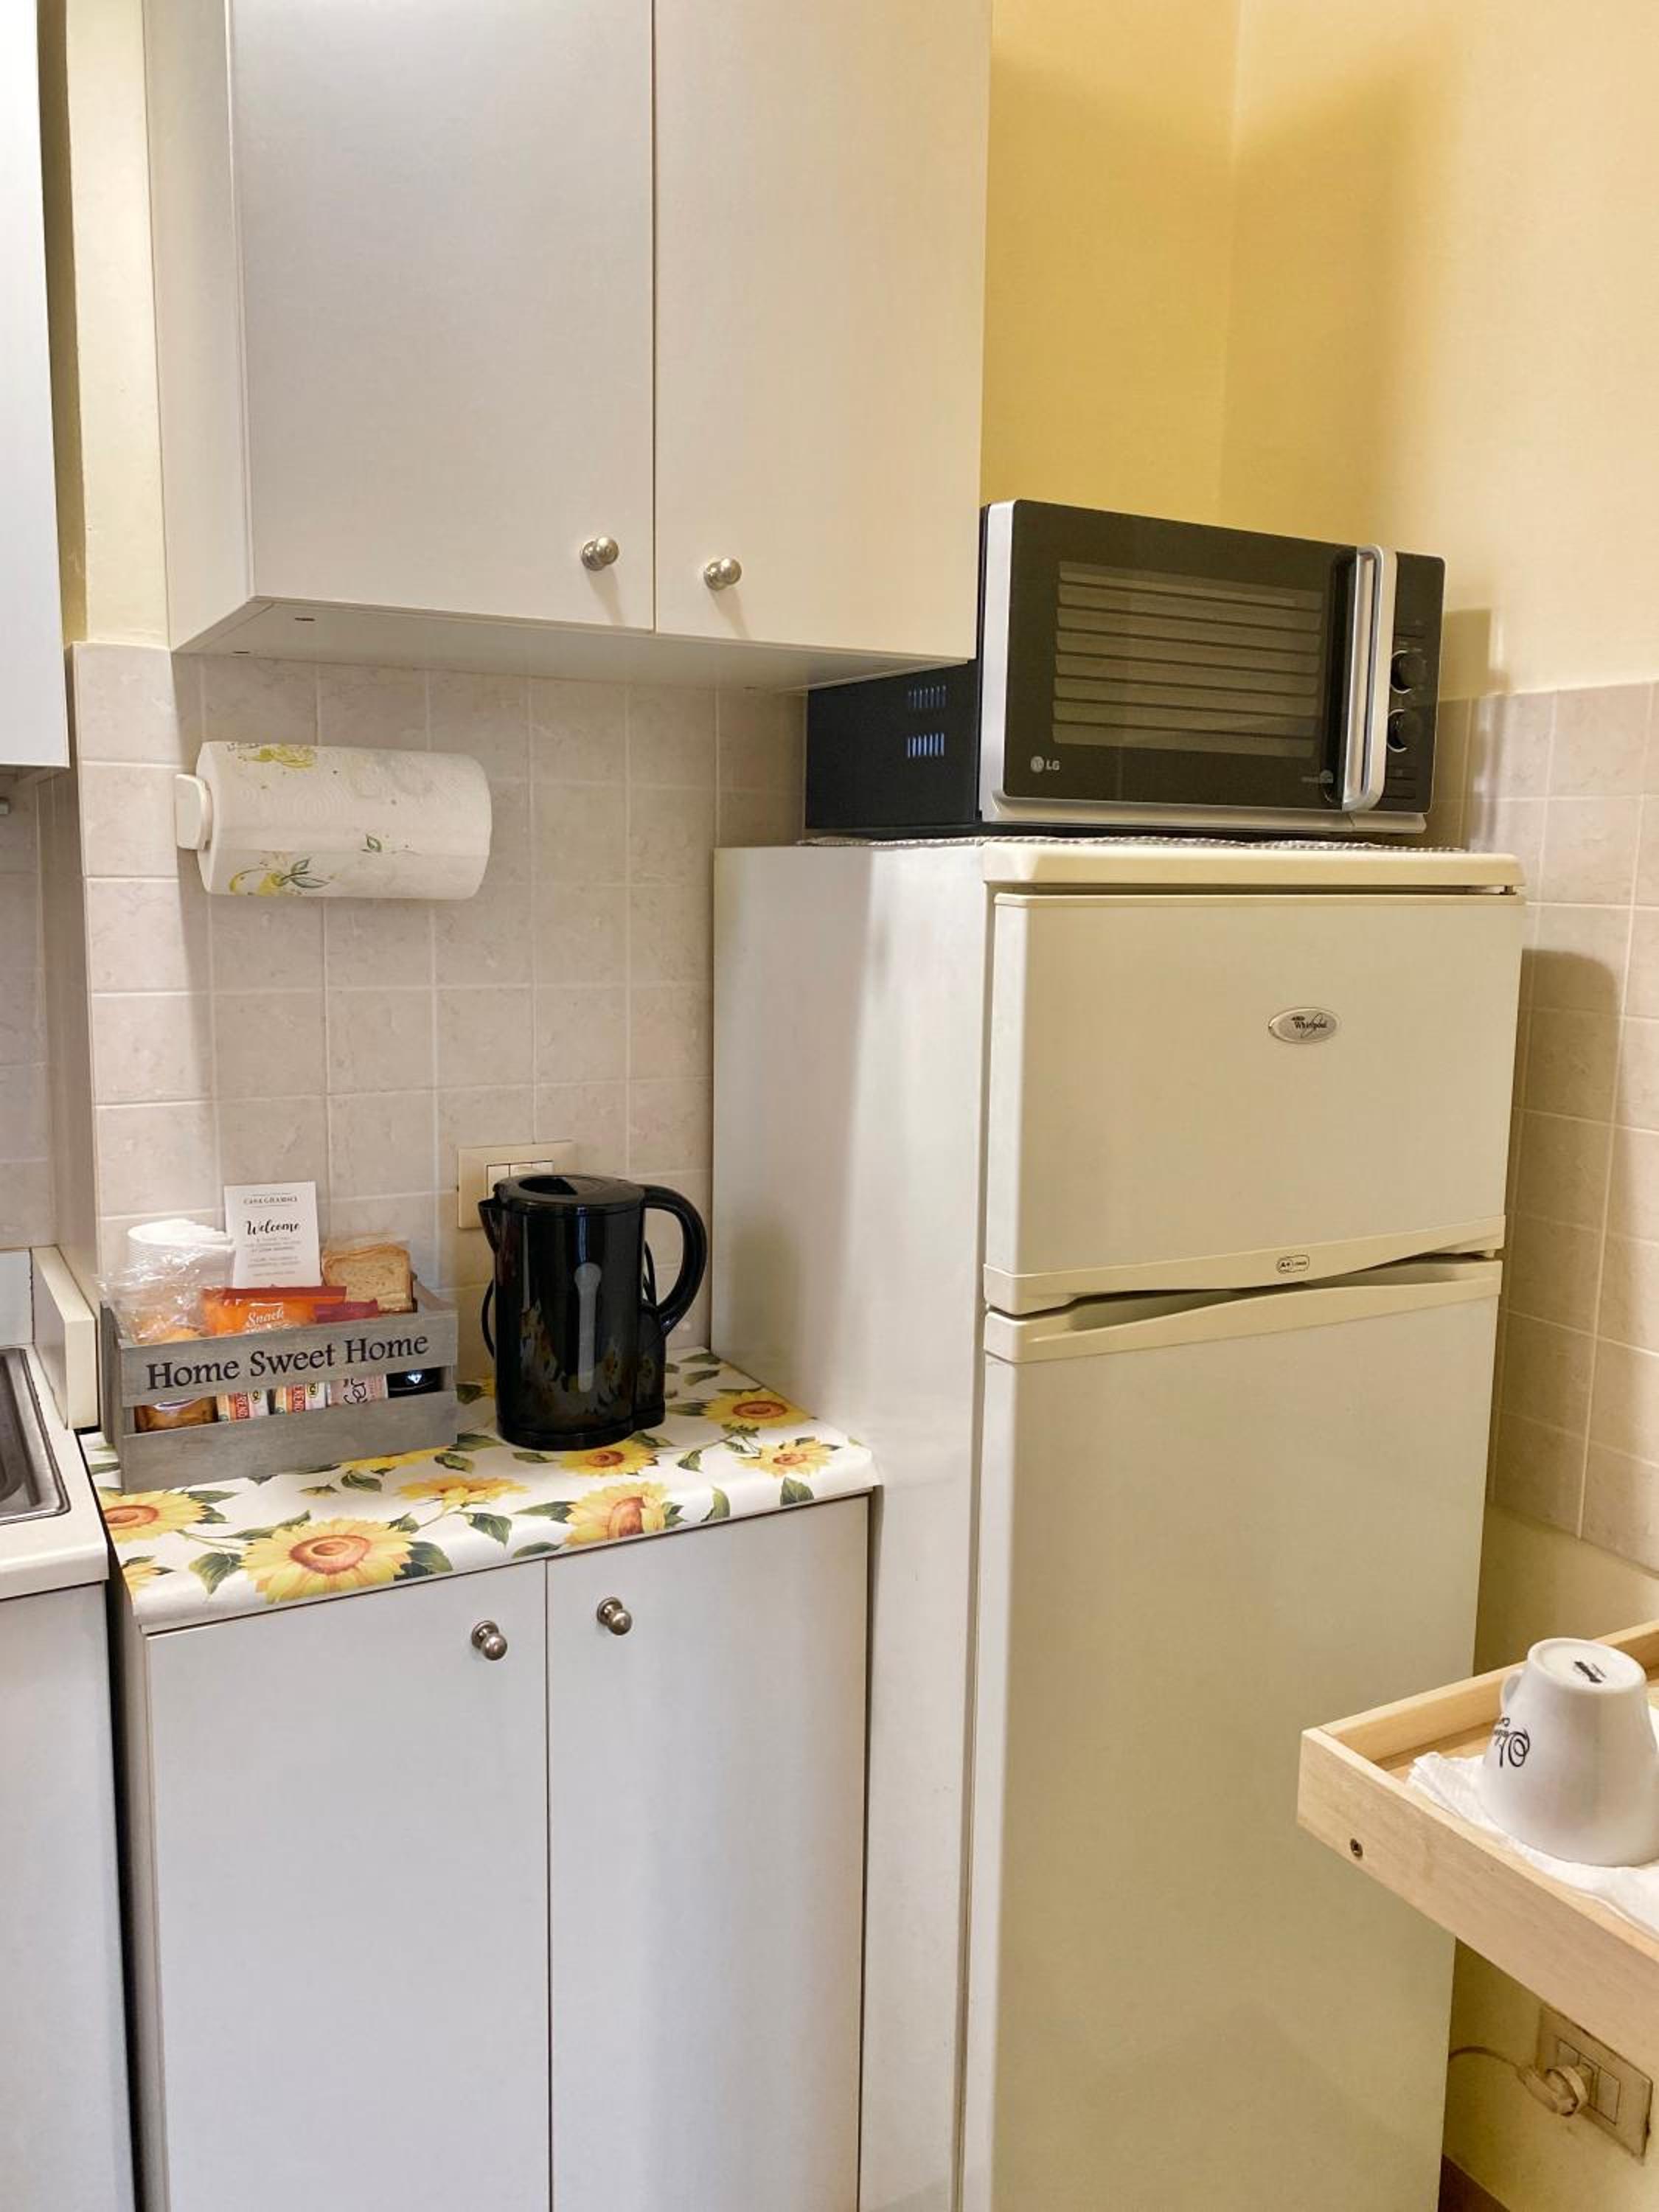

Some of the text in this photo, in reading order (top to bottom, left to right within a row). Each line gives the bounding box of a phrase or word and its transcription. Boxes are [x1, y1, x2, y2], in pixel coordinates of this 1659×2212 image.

[1046, 760, 1060, 771] LG
[247, 1220, 299, 1235] Welcome
[146, 1336, 429, 1390] Home Sweet Home
